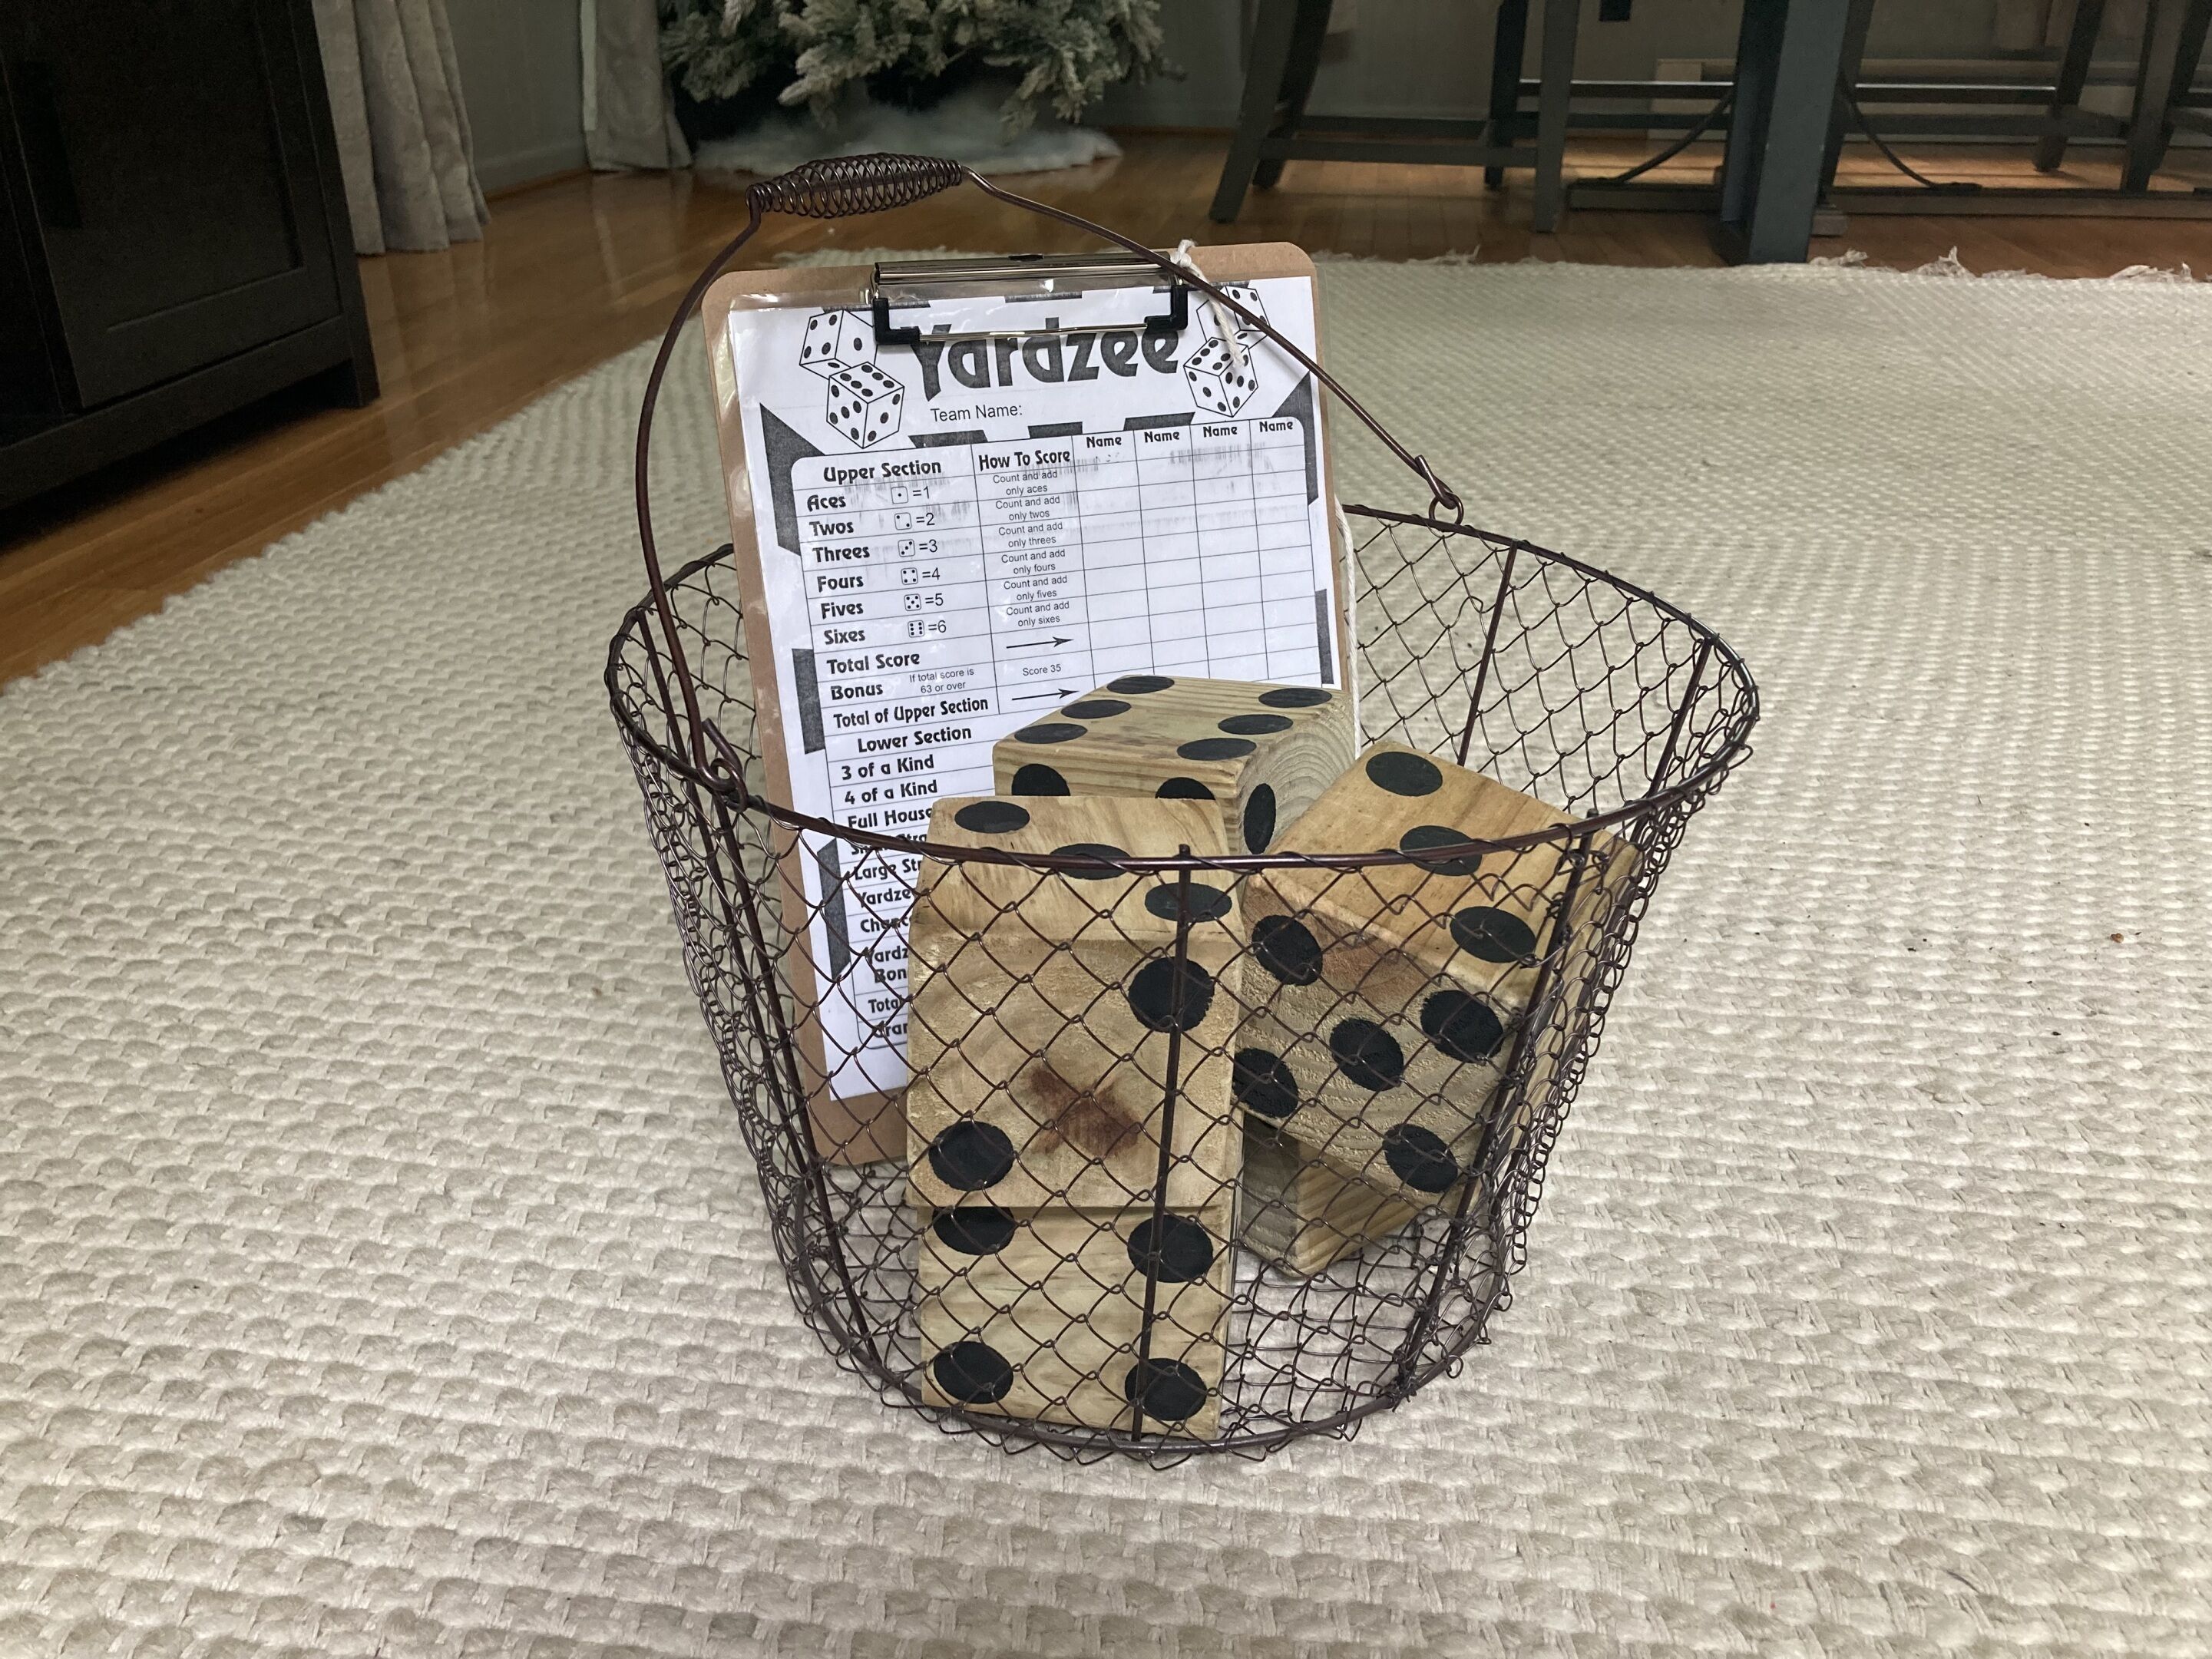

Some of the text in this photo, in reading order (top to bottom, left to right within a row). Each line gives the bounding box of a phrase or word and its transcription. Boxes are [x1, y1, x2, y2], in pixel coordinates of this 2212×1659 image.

[901, 316, 1179, 402] Yardzee
[930, 405, 1023, 422] Team Name:
[1203, 425, 1238, 438] Name
[1259, 421, 1294, 433] Name
[1086, 435, 1122, 448] Name
[1144, 430, 1180, 443] Name
[978, 450, 1070, 471] How To Score
[823, 460, 941, 485] Upper Section
[993, 470, 1058, 484] Count and add
[1006, 485, 1048, 496] only aces
[807, 494, 846, 512] Aces
[996, 495, 1060, 509] Count and add
[1009, 511, 1050, 522] only twos
[809, 521, 854, 537] Twos
[999, 522, 1063, 536] Count and add
[1008, 537, 1056, 548] only threes
[812, 546, 870, 563] Threes
[1001, 549, 1066, 563] Count and add
[1013, 563, 1056, 575] only fours
[817, 575, 864, 593] Fours
[1004, 575, 1067, 590] Count and add
[1017, 590, 1057, 601] only fives
[821, 602, 864, 620] Fives
[1006, 601, 1070, 616] Count and add
[1018, 615, 1060, 627] only sixes
[824, 629, 865, 645] Sixes
[827, 653, 921, 675] Total Score
[1023, 664, 1061, 676] Score 35
[909, 674, 918, 682] If
[918, 672, 937, 682] total
[940, 670, 964, 679] score
[831, 684, 884, 701] Bonus
[921, 686, 932, 694] 63
[946, 682, 966, 691] over
[833, 698, 989, 729] Total of Upper Section
[858, 727, 972, 753] Lower Section
[841, 754, 934, 781] 3 of a Kind
[845, 779, 937, 805] 4 of a Kind
[848, 813, 878, 828] Full
[858, 888, 914, 907] Yardze
